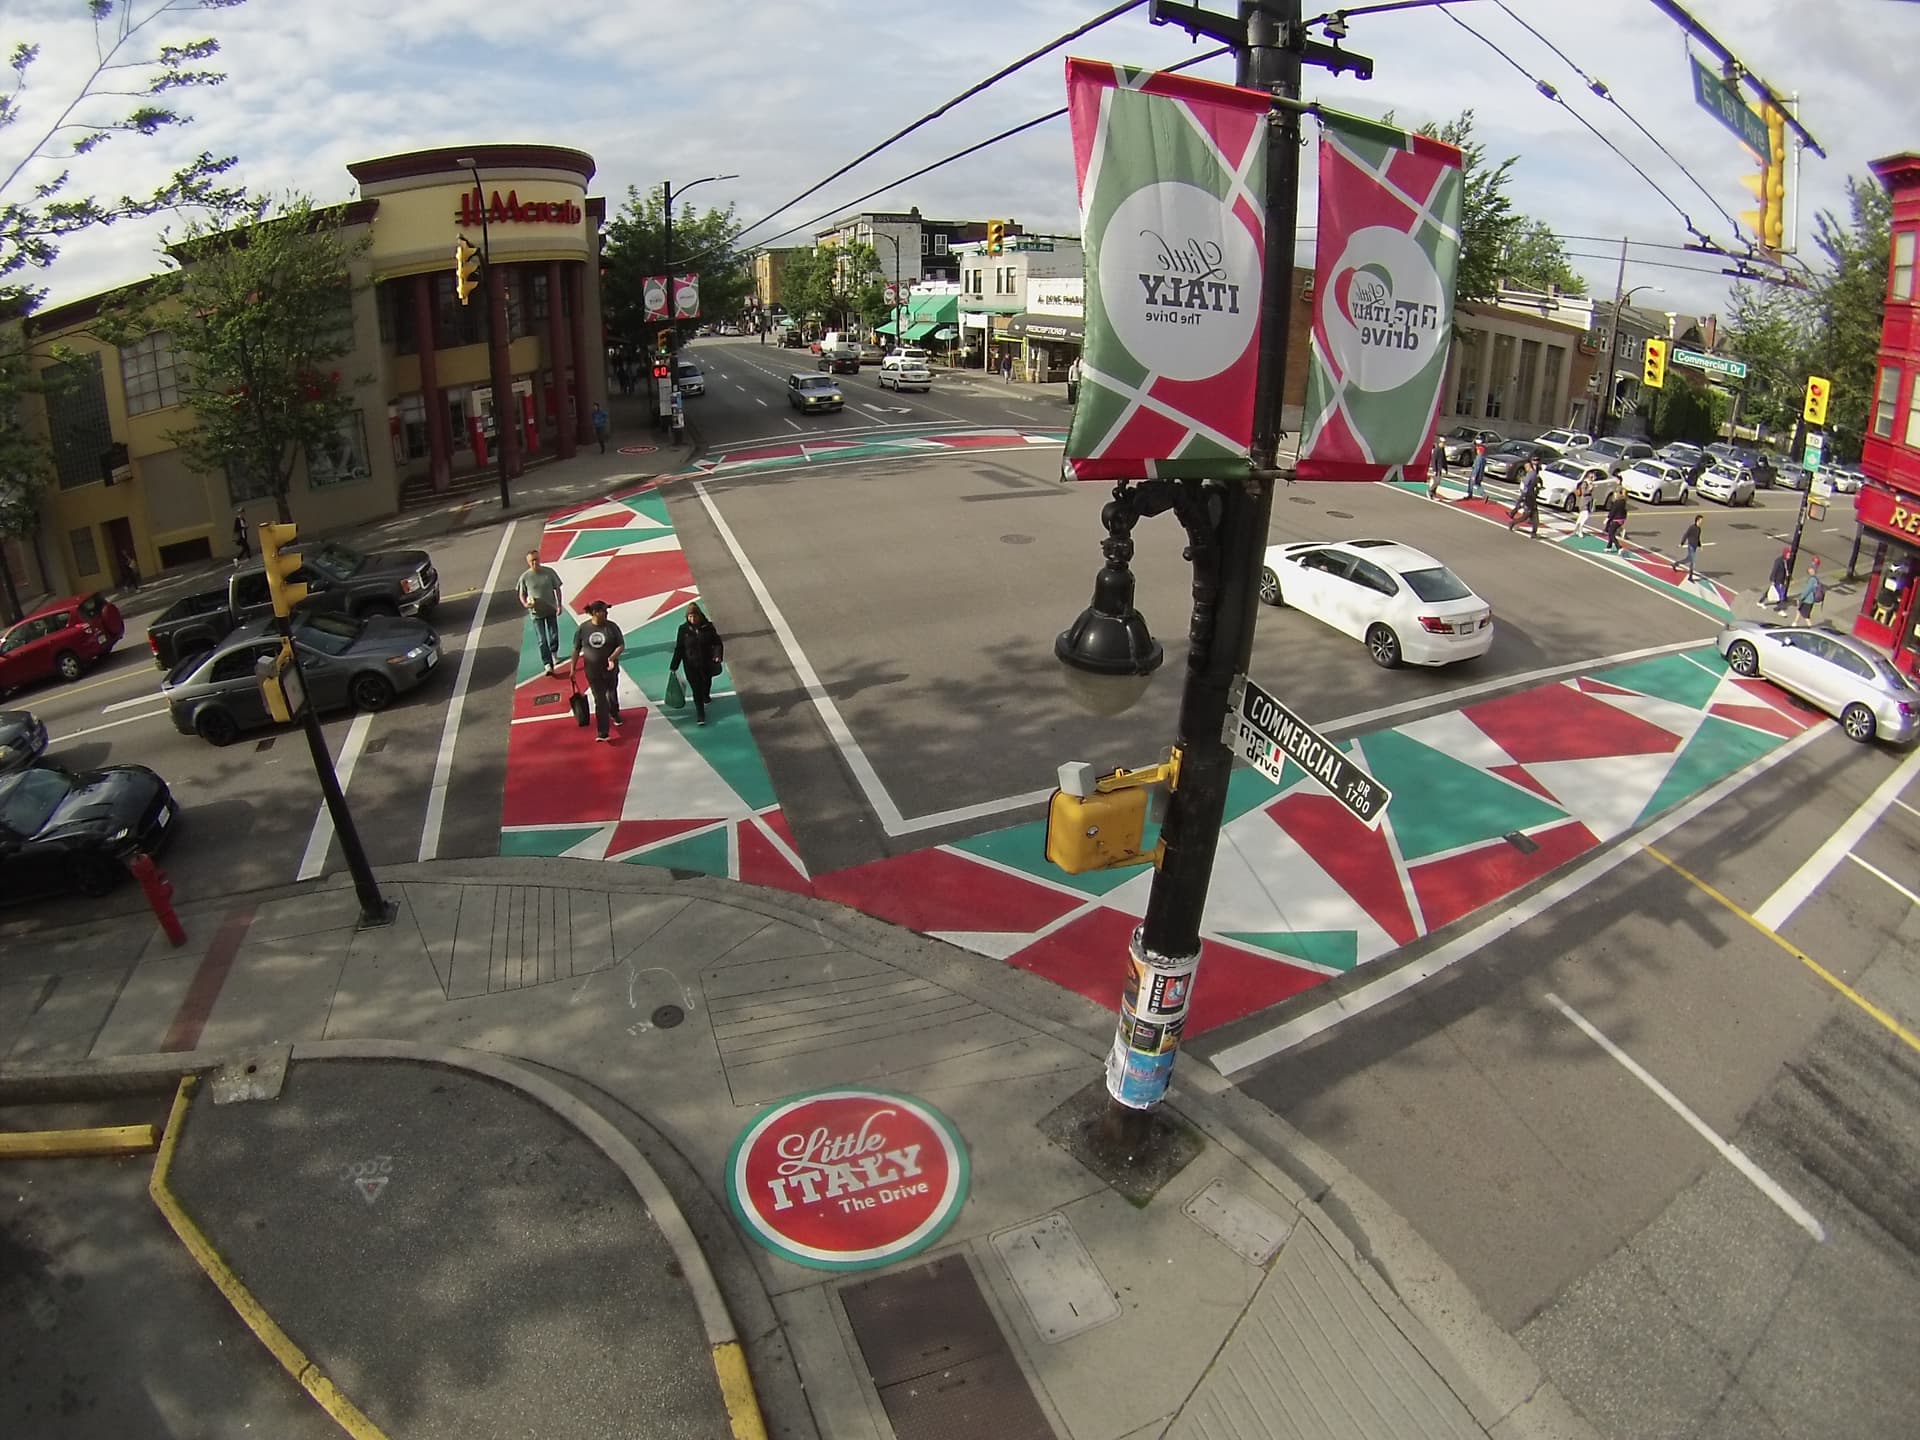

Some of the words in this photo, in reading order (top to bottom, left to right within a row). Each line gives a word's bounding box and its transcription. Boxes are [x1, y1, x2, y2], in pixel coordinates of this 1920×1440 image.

[1701, 72, 1714, 105] E
[1718, 89, 1739, 128] 1st
[1744, 112, 1766, 151] Ave
[1677, 352, 1728, 371] Commercial
[1730, 363, 1741, 374] Dr
[1889, 506, 1920, 537] RE
[1239, 722, 1268, 754] the
[1250, 695, 1344, 790] COMMERCIAL
[1246, 744, 1280, 778] drive
[1345, 786, 1370, 814] 1700
[1357, 780, 1371, 798] DR
[777, 1109, 897, 1172] Little
[767, 1144, 922, 1211] ITALY
[838, 1197, 876, 1215] The
[880, 1181, 929, 1205] Drive
